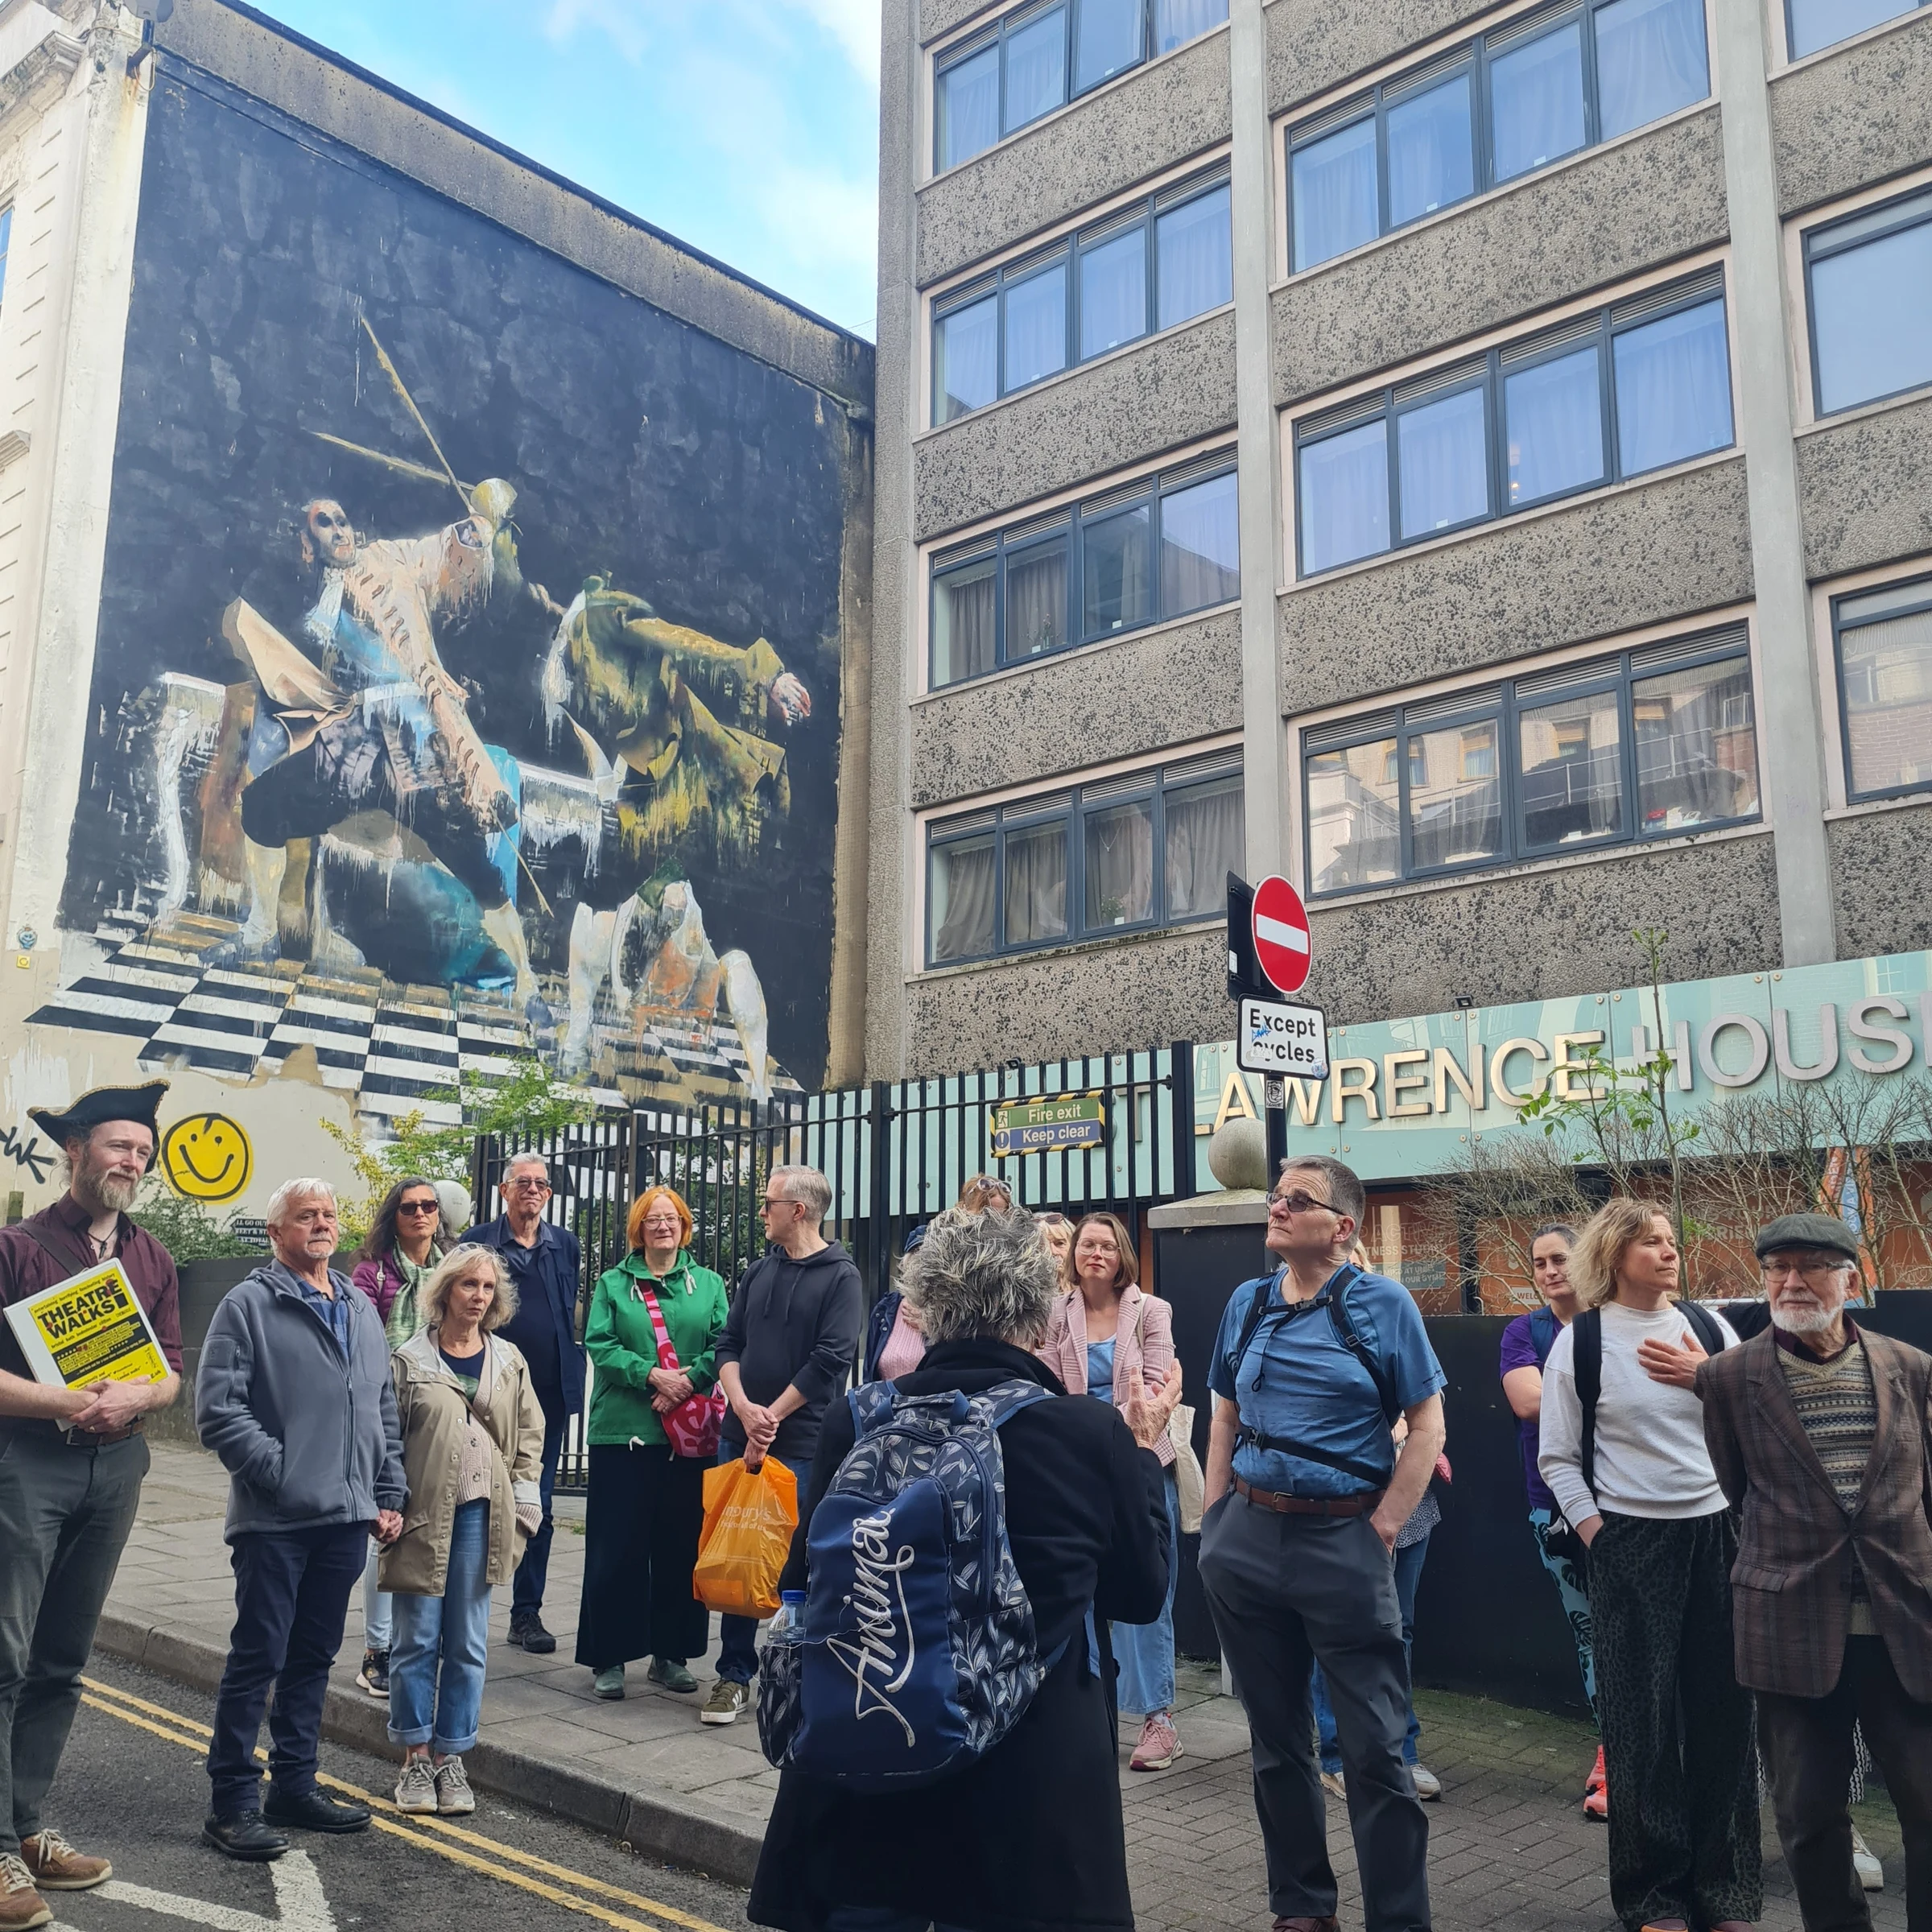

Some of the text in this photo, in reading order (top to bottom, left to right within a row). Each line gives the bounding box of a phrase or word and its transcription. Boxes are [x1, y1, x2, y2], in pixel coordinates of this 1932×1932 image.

[1250, 1008, 1316, 1038] Except
[1195, 1030, 1608, 1136] AWRENCE
[1632, 991, 1932, 1092] HOUS
[1028, 1104, 1082, 1122] Fire exit
[1022, 1125, 1091, 1145] Keep clear
[1365, 1245, 1399, 1256] TNESS
[38, 1279, 122, 1329] THEATRE
[47, 1298, 115, 1340] WALKS
